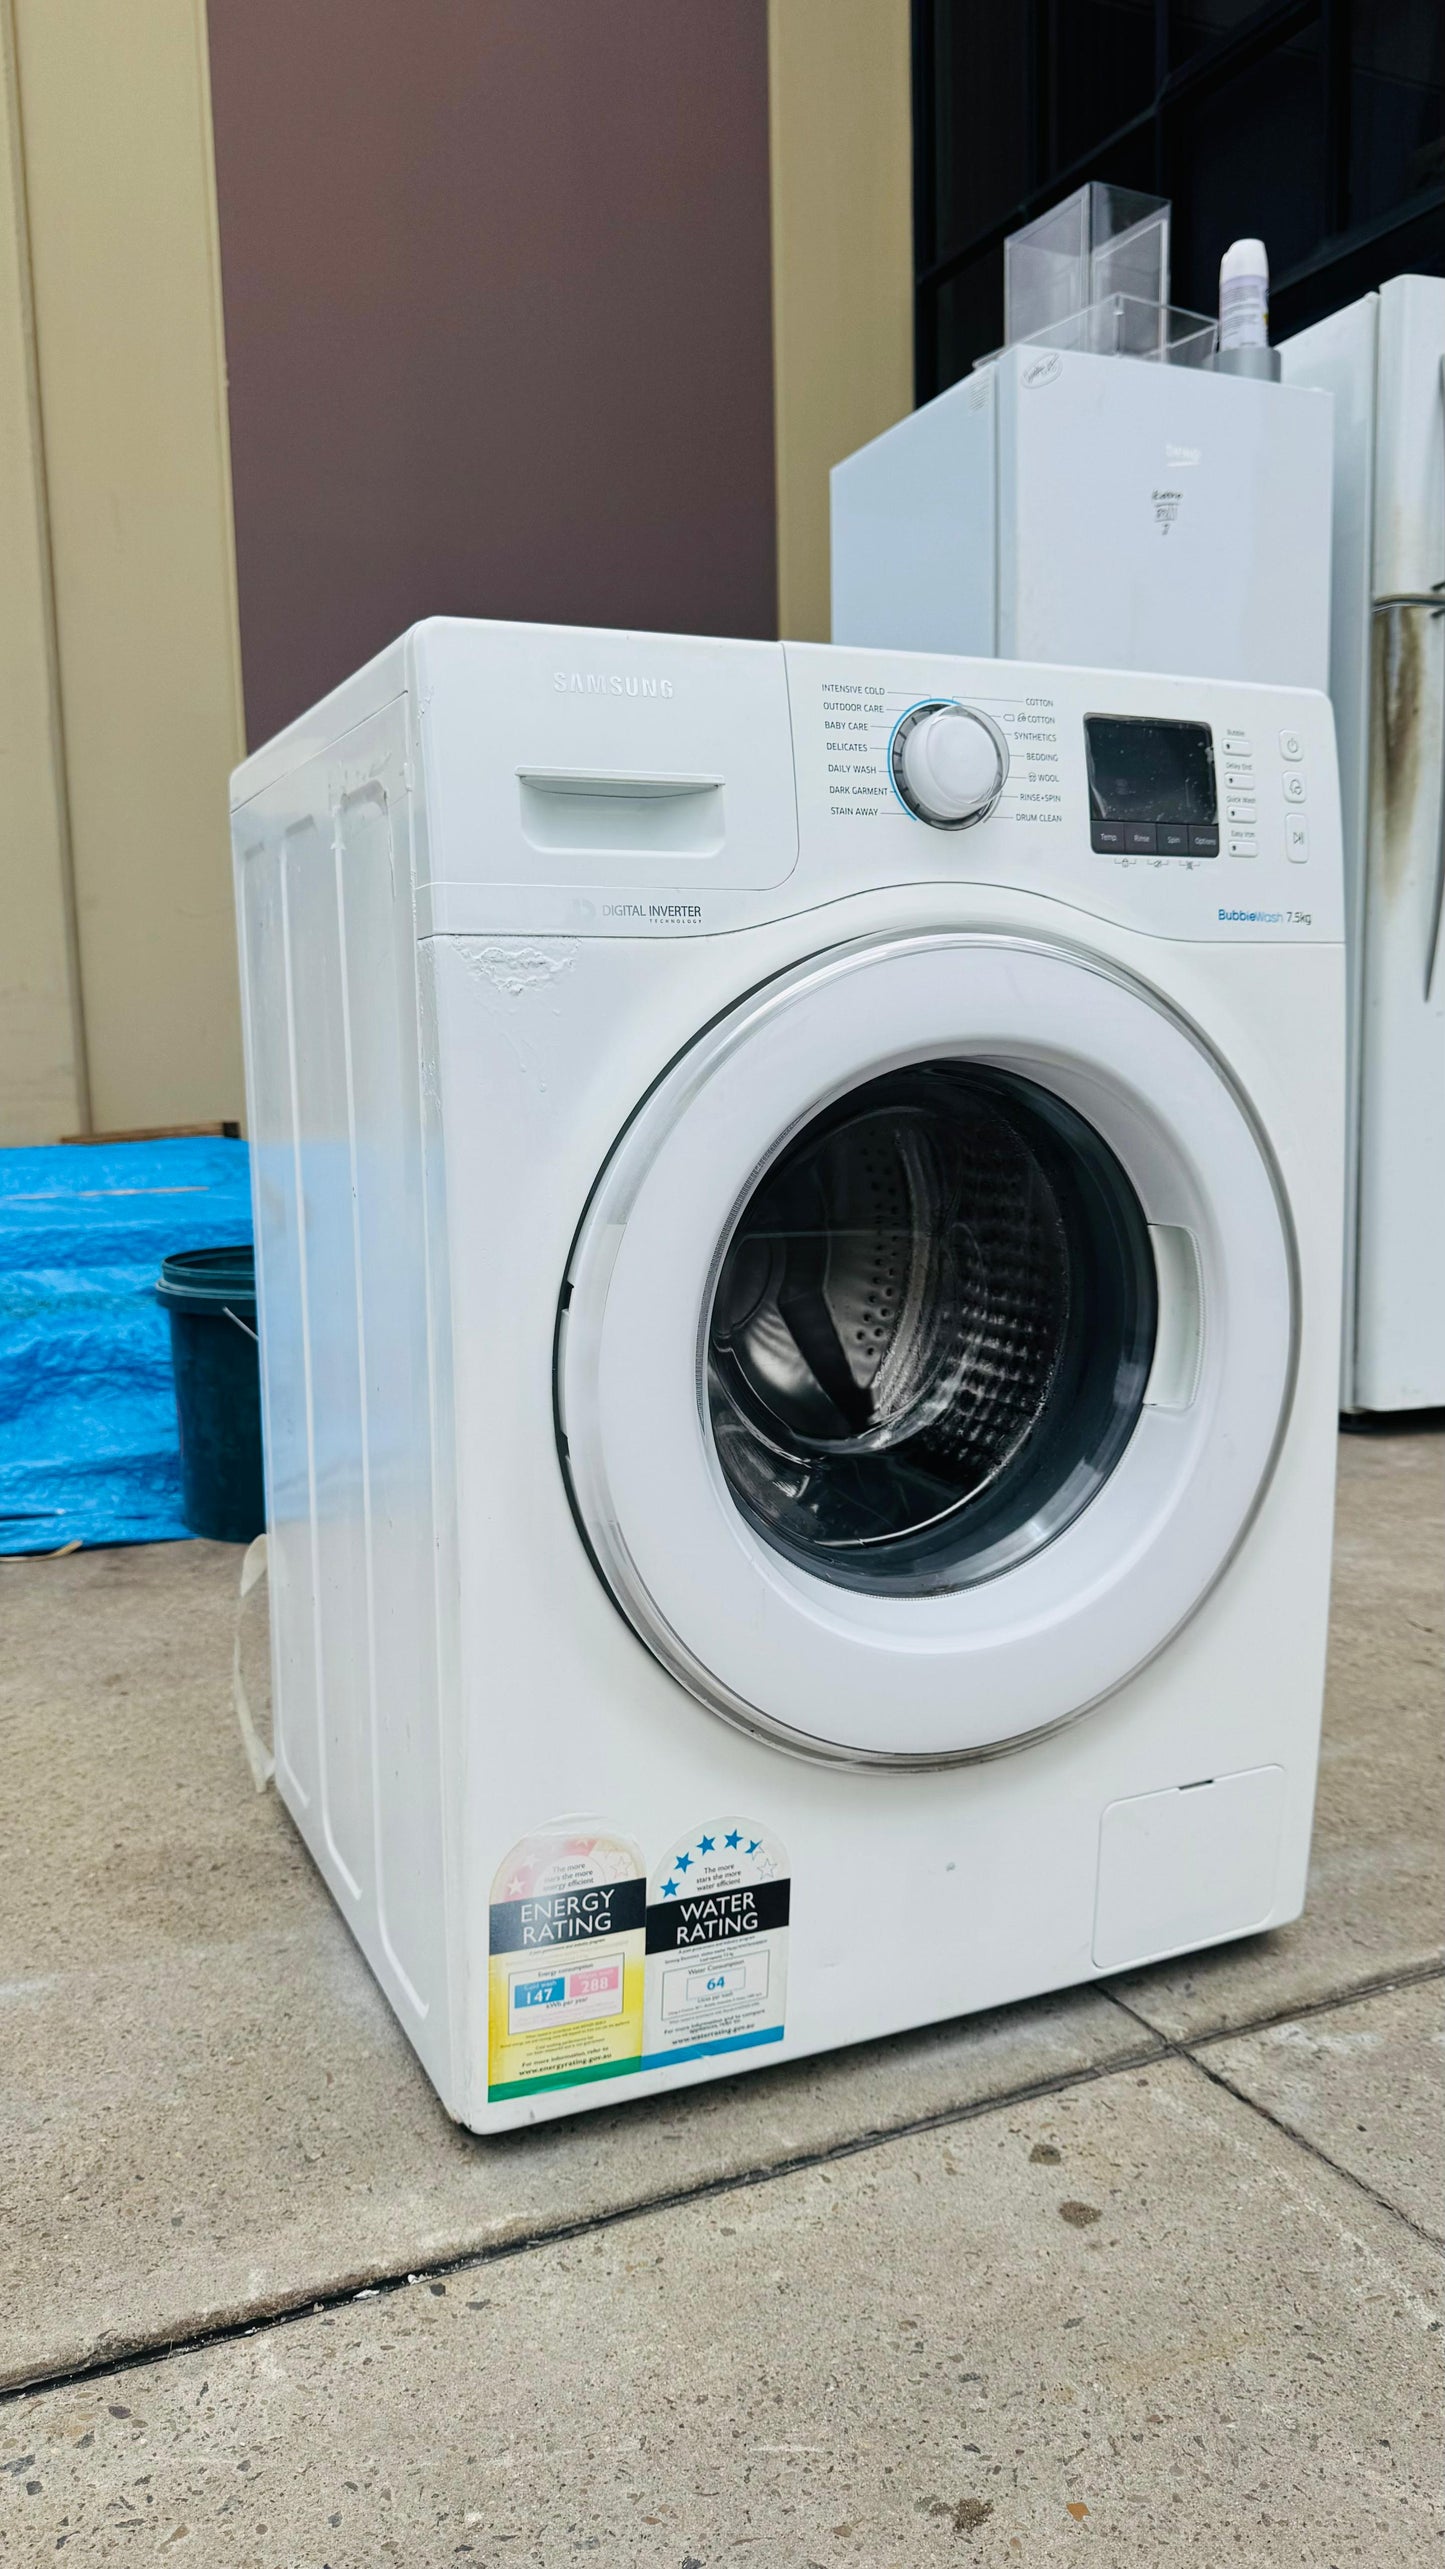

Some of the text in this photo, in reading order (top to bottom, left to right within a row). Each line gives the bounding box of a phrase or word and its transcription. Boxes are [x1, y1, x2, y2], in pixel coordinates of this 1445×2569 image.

[553, 671, 673, 699] SAMSUNG
[822, 684, 885, 695] INTENSIVE COLD
[823, 702, 884, 713] OUTDOOR CARE
[1025, 698, 1054, 707] COTTON
[1027, 715, 1055, 724] COTTON
[824, 721, 868, 731] BABY CARE
[1014, 732, 1057, 742] SYNTHETICS
[826, 742, 868, 752] DELICATES
[1026, 752, 1058, 761] BEDDING
[828, 764, 877, 774] DAILY WASH
[1038, 774, 1060, 782] WOOL
[829, 785, 888, 796] DARK GARMENT
[830, 807, 879, 816] STAIN AWAY
[1016, 814, 1062, 822] DRUM CLEAN
[602, 904, 701, 917] DIGITAL INVERTER
[1286, 911, 1312, 926] 7.5kg
[567, 1863, 585, 1871] more
[574, 1870, 593, 1878] more
[696, 1876, 711, 1884] stars
[713, 1873, 723, 1881] the
[568, 1878, 594, 1888] efficient
[717, 1879, 741, 1888] efficient
[521, 1889, 615, 1923] ENERGY
[680, 1892, 756, 1922] WATER
[523, 1913, 611, 1945] RATING
[677, 1912, 758, 1945] RATING
[580, 1977, 609, 1992] 288
[707, 1976, 725, 1991] 64
[526, 1988, 553, 2004] 147
